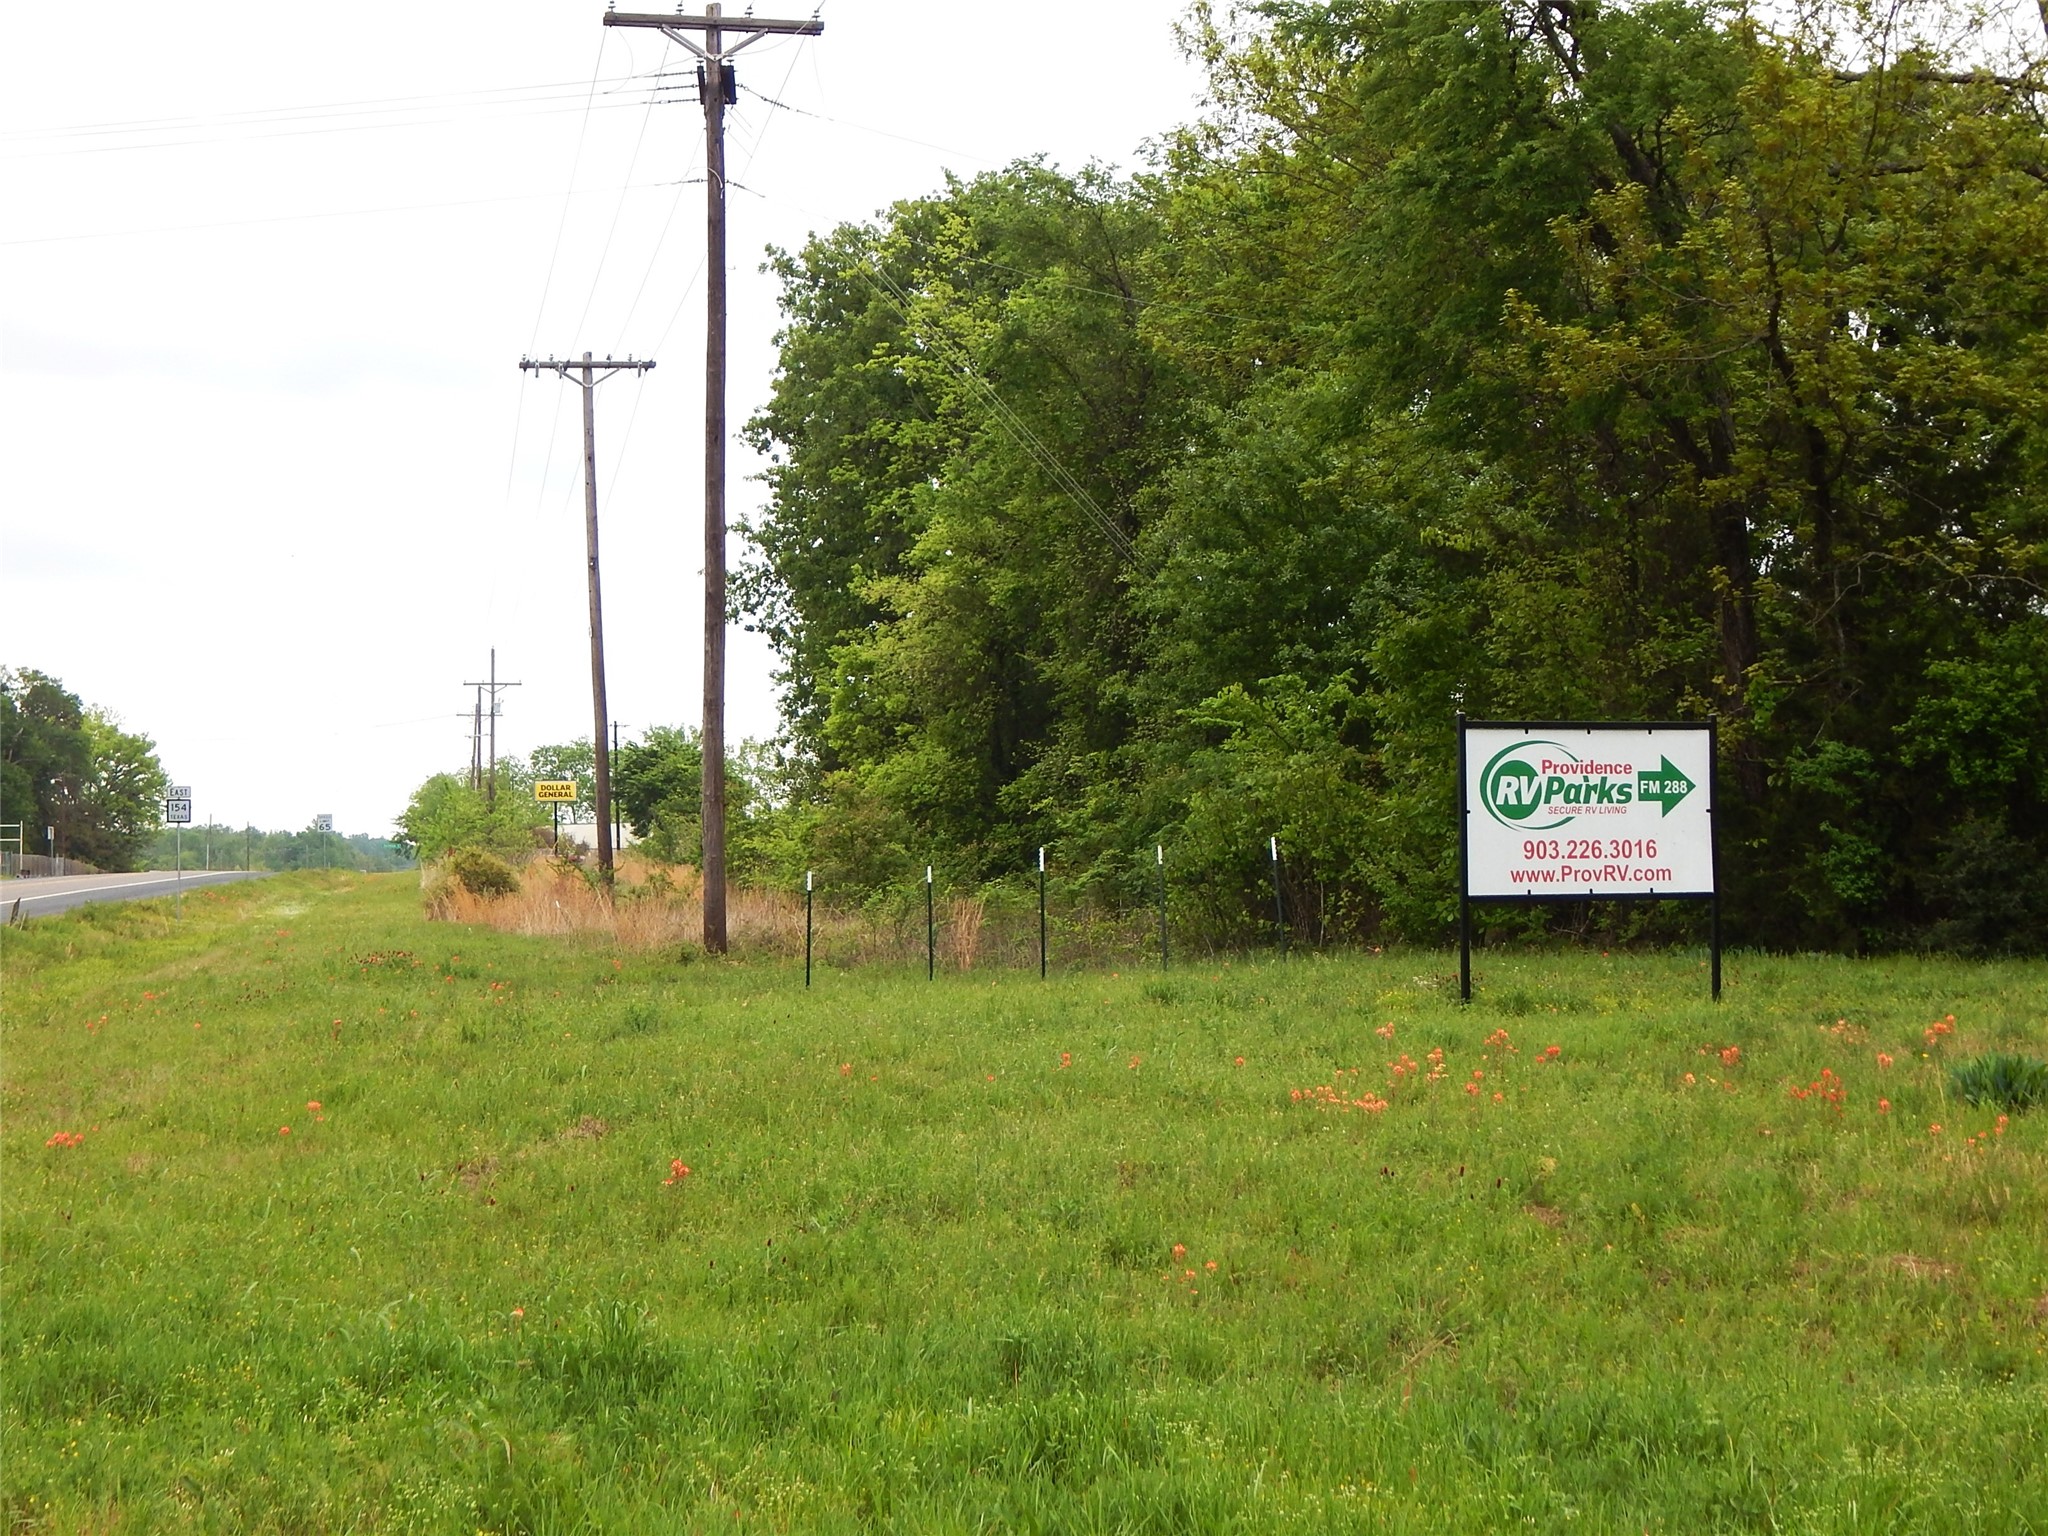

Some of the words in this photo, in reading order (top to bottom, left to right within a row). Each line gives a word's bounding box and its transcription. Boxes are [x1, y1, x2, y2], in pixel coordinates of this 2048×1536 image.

[1541, 759, 1633, 775] Providence
[1495, 775, 1540, 806] RV
[1543, 775, 1633, 805] Parks
[1640, 780, 1661, 794] FM
[1663, 780, 1688, 794] 288
[171, 803, 187, 812] 154
[1547, 806, 1583, 815] SECURE
[1584, 806, 1598, 815] RV
[1598, 806, 1627, 815] LIVING
[319, 823, 331, 831] 65
[1523, 839, 1658, 860] 903.226.3016
[1510, 864, 1672, 883] www.ProvRV.com
